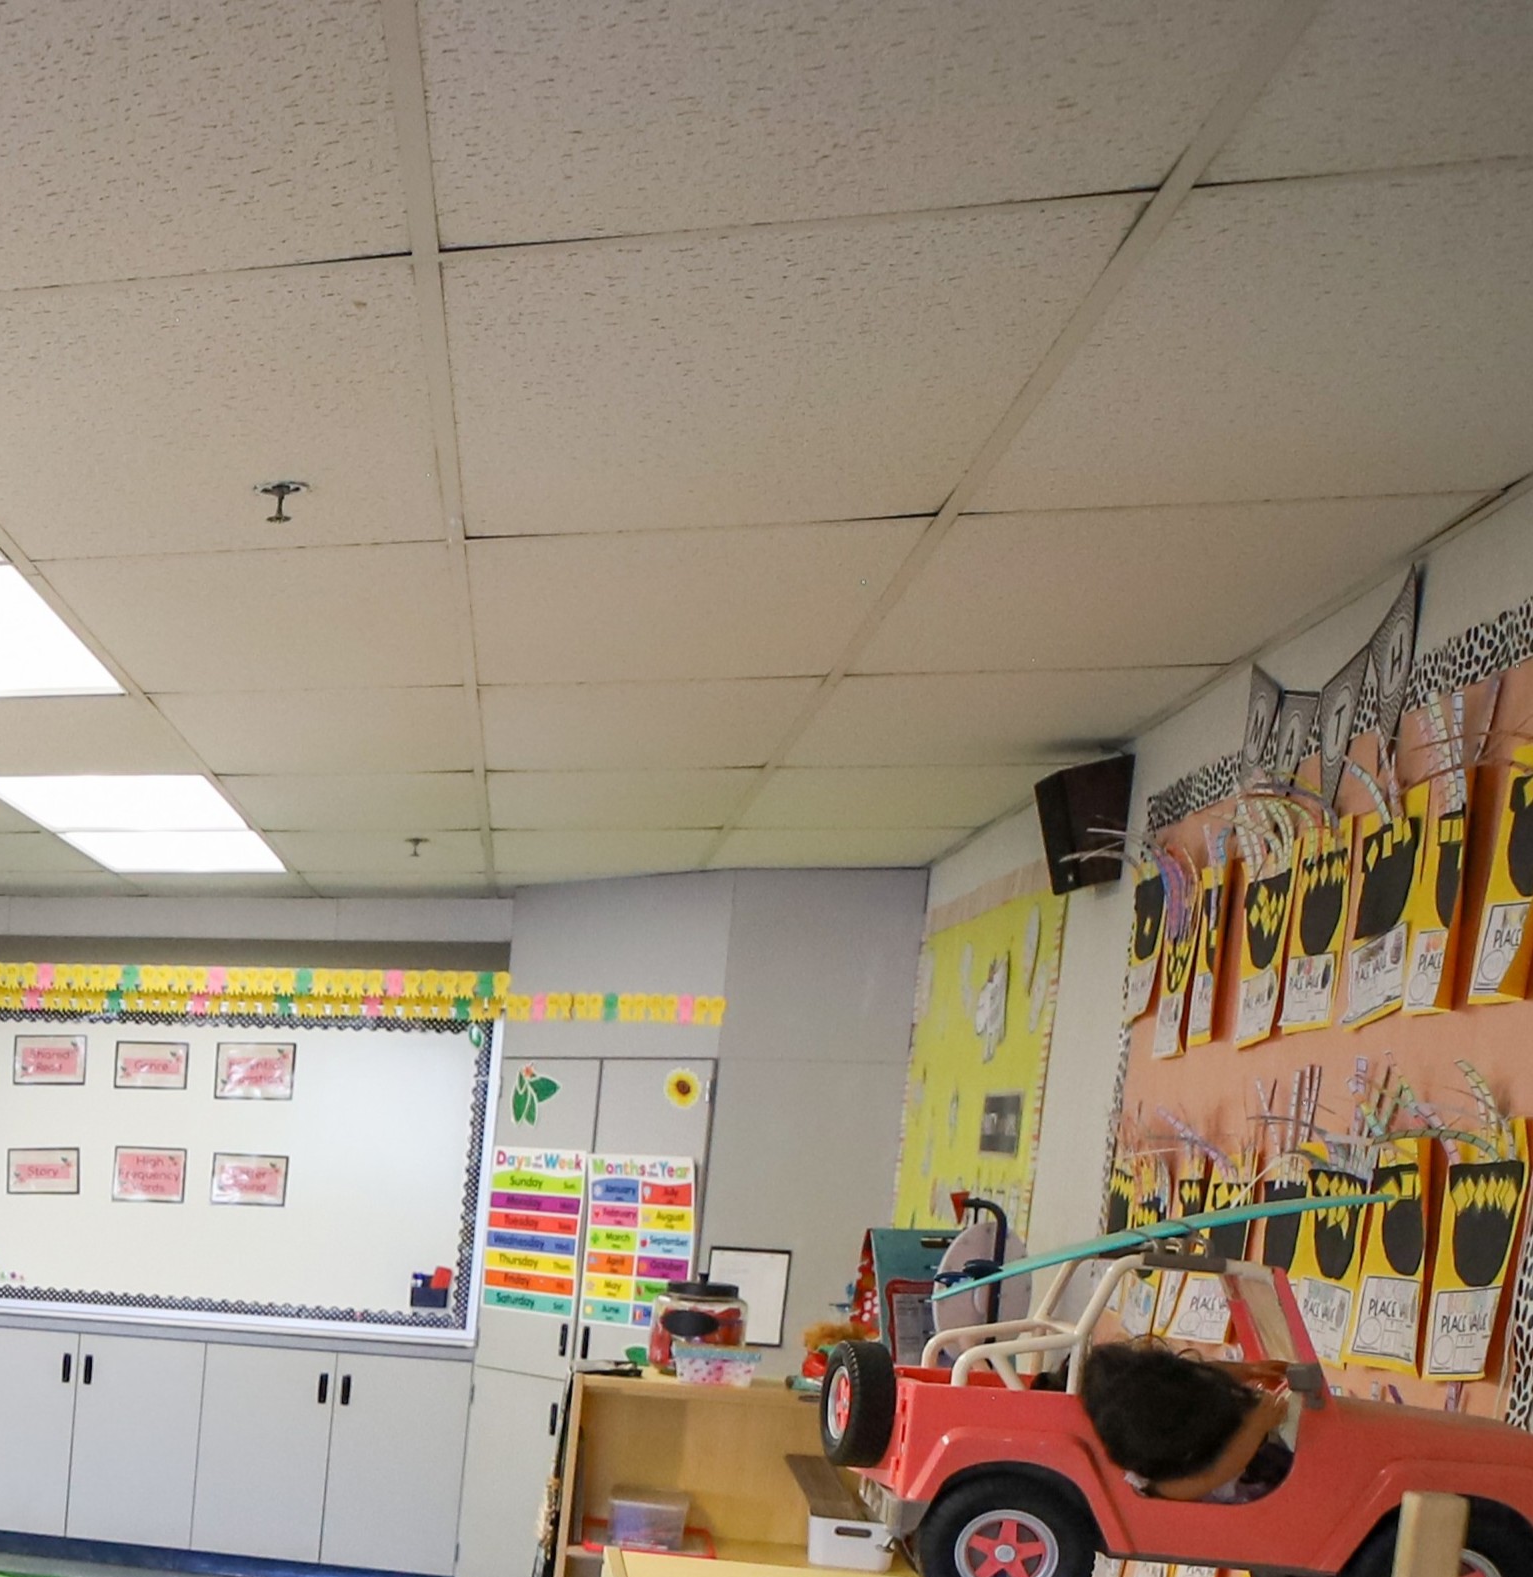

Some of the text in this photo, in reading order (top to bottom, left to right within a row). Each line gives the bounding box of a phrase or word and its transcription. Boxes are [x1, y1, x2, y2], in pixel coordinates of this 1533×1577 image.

[1493, 928, 1522, 949] PLACE
[1417, 953, 1442, 971] PLACE
[136, 1155, 166, 1169] High
[495, 1150, 583, 1171] Days Week
[592, 1157, 691, 1179] Months Year
[27, 1166, 59, 1179] Story
[509, 1175, 544, 1190] Sunday
[604, 1184, 637, 1197] January
[663, 1186, 679, 1199] July
[506, 1195, 543, 1210] Monday
[504, 1214, 540, 1230] Tuesday
[655, 1211, 686, 1223] August
[493, 1234, 545, 1251] Wednesday
[604, 1231, 631, 1243] March
[649, 1235, 690, 1249] September
[498, 1253, 539, 1269] Thursday
[605, 1255, 626, 1268] April
[503, 1273, 531, 1288] Friday
[603, 1280, 623, 1292] May
[496, 1292, 535, 1308] Saturday
[1368, 1298, 1398, 1315] PLACE
[601, 1305, 621, 1316] June
[1441, 1315, 1467, 1332] PLACE
